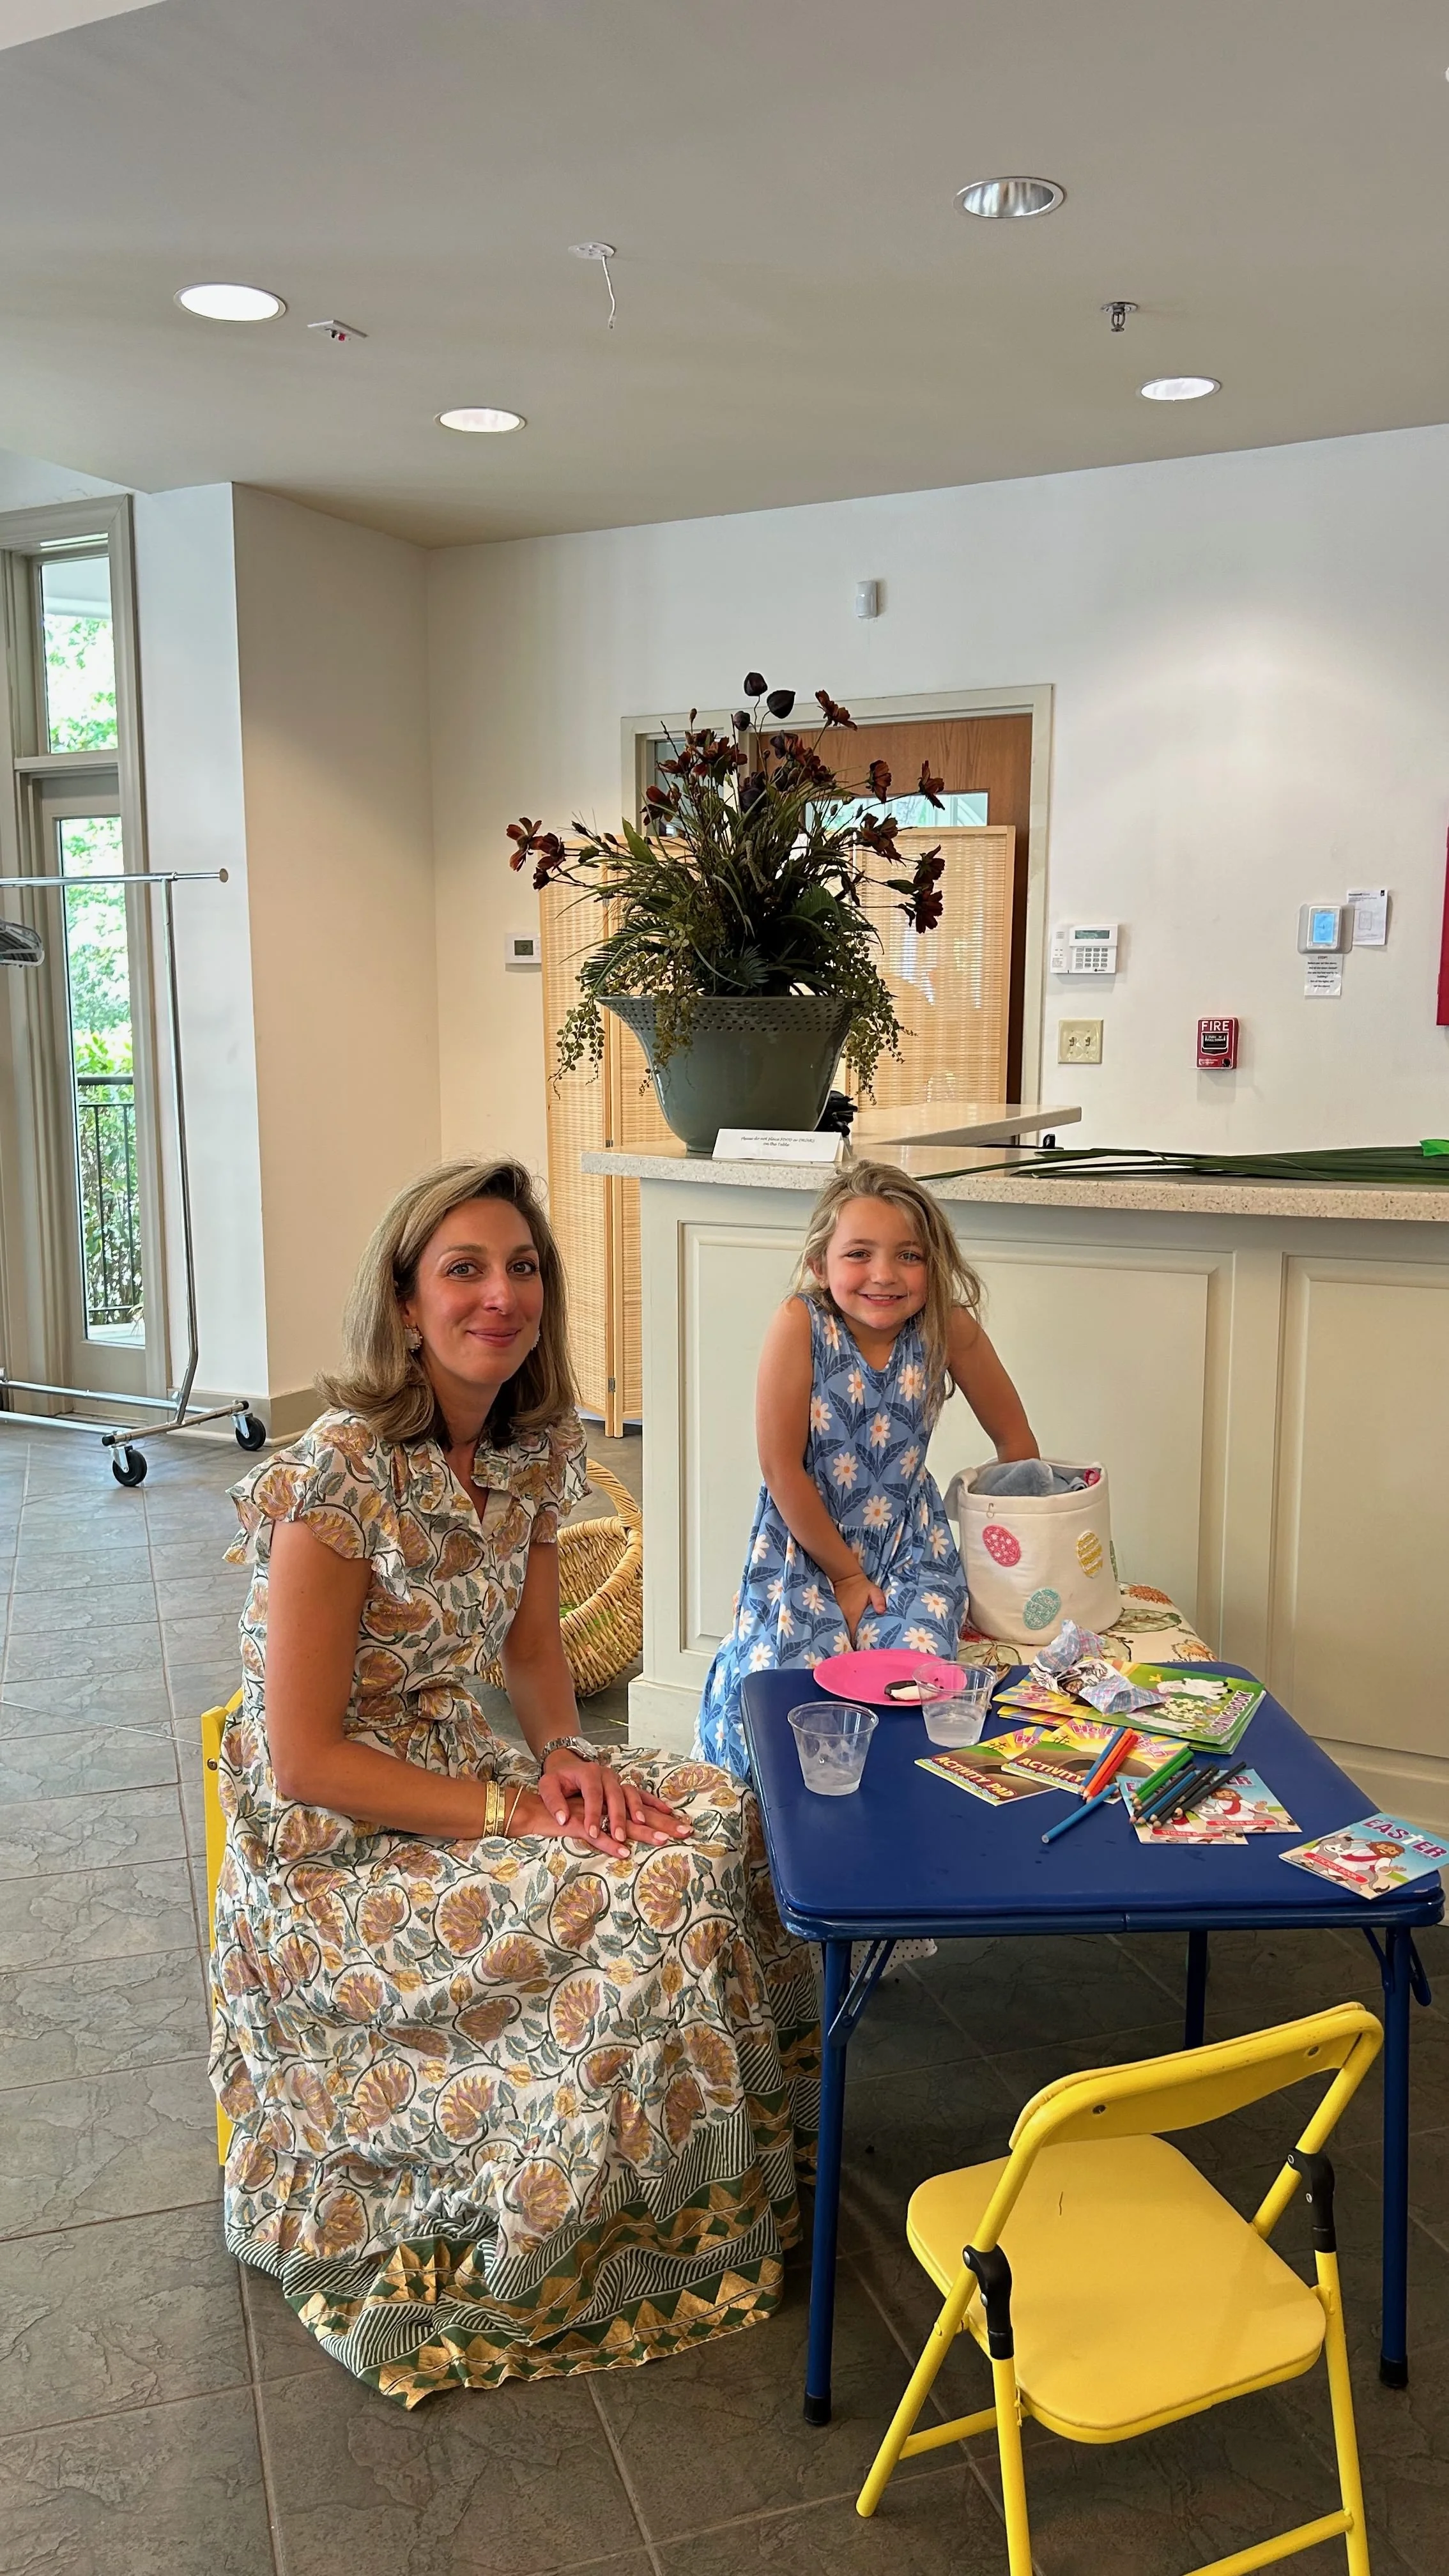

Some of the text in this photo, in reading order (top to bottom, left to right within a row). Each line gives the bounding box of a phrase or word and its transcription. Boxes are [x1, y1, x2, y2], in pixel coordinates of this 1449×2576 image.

[1202, 1020, 1230, 1031] FIRE
[1201, 1690, 1254, 1735] ORING BOOK
[934, 1756, 992, 1783] ACTIVITY
[986, 1782, 1015, 1797] PAD
[1017, 1758, 1085, 1782] ACTIVITY
[1312, 1855, 1356, 1879] STICKER BOOK
